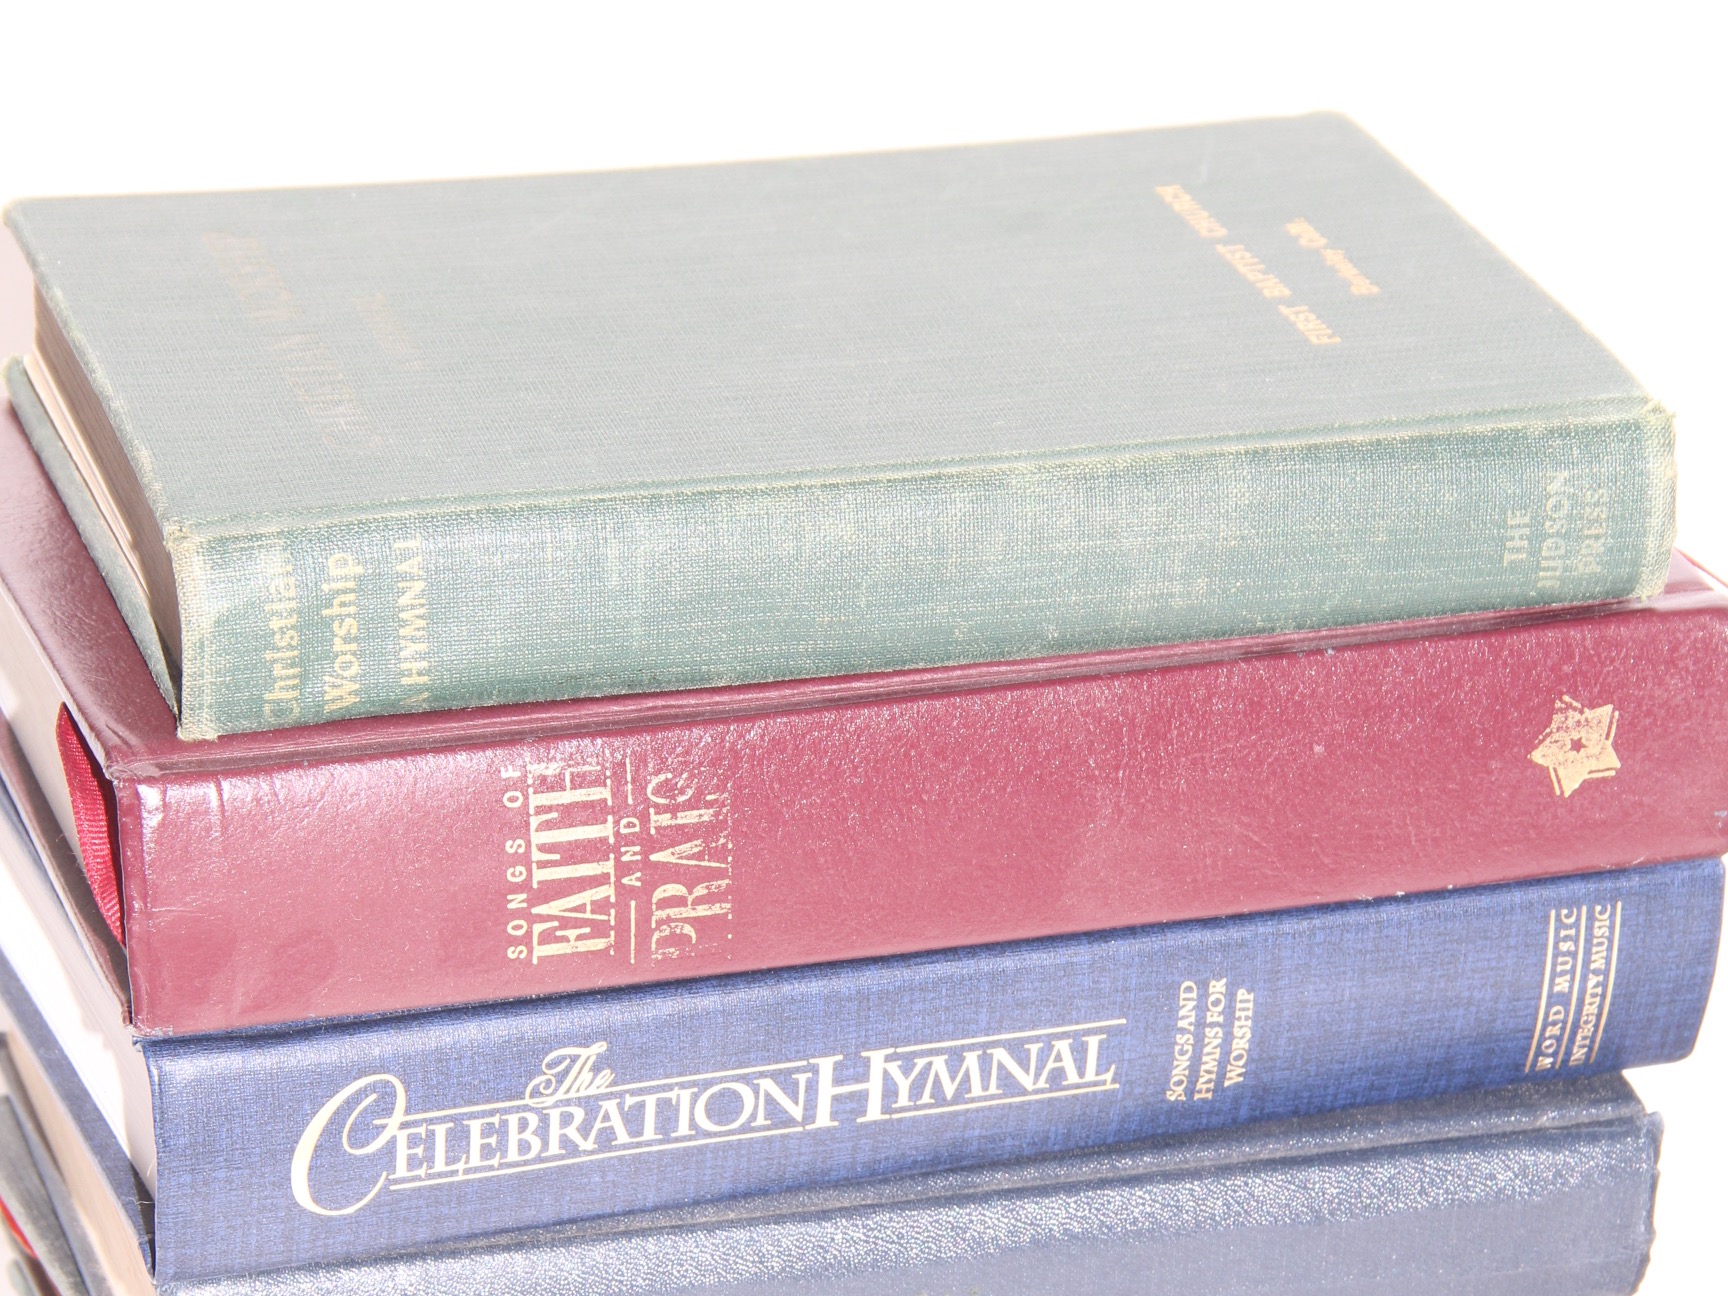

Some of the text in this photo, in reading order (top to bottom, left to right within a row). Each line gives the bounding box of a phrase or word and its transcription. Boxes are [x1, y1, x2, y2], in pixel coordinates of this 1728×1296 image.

[1155, 184, 1341, 345] FIRST BAPTIST CHURCH
[394, 534, 431, 685] HYMNAL
[1503, 508, 1531, 570] THE
[322, 553, 365, 713] Worship
[500, 765, 528, 959] SONGS OF
[526, 755, 616, 965] FAITH
[619, 816, 641, 886] AND
[646, 765, 733, 962] PRAIS
[1165, 980, 1198, 1101] SONGS AND
[1194, 977, 1227, 1101] HYMNS FOR
[1223, 988, 1254, 1087] WORSHIP
[1535, 908, 1576, 1071] WORD MUSIC
[1569, 904, 1610, 1067] INTEGRITY MUSIC
[291, 1033, 1119, 1216] CELEBRATION HYMNAL
[525, 1041, 617, 1107] The
